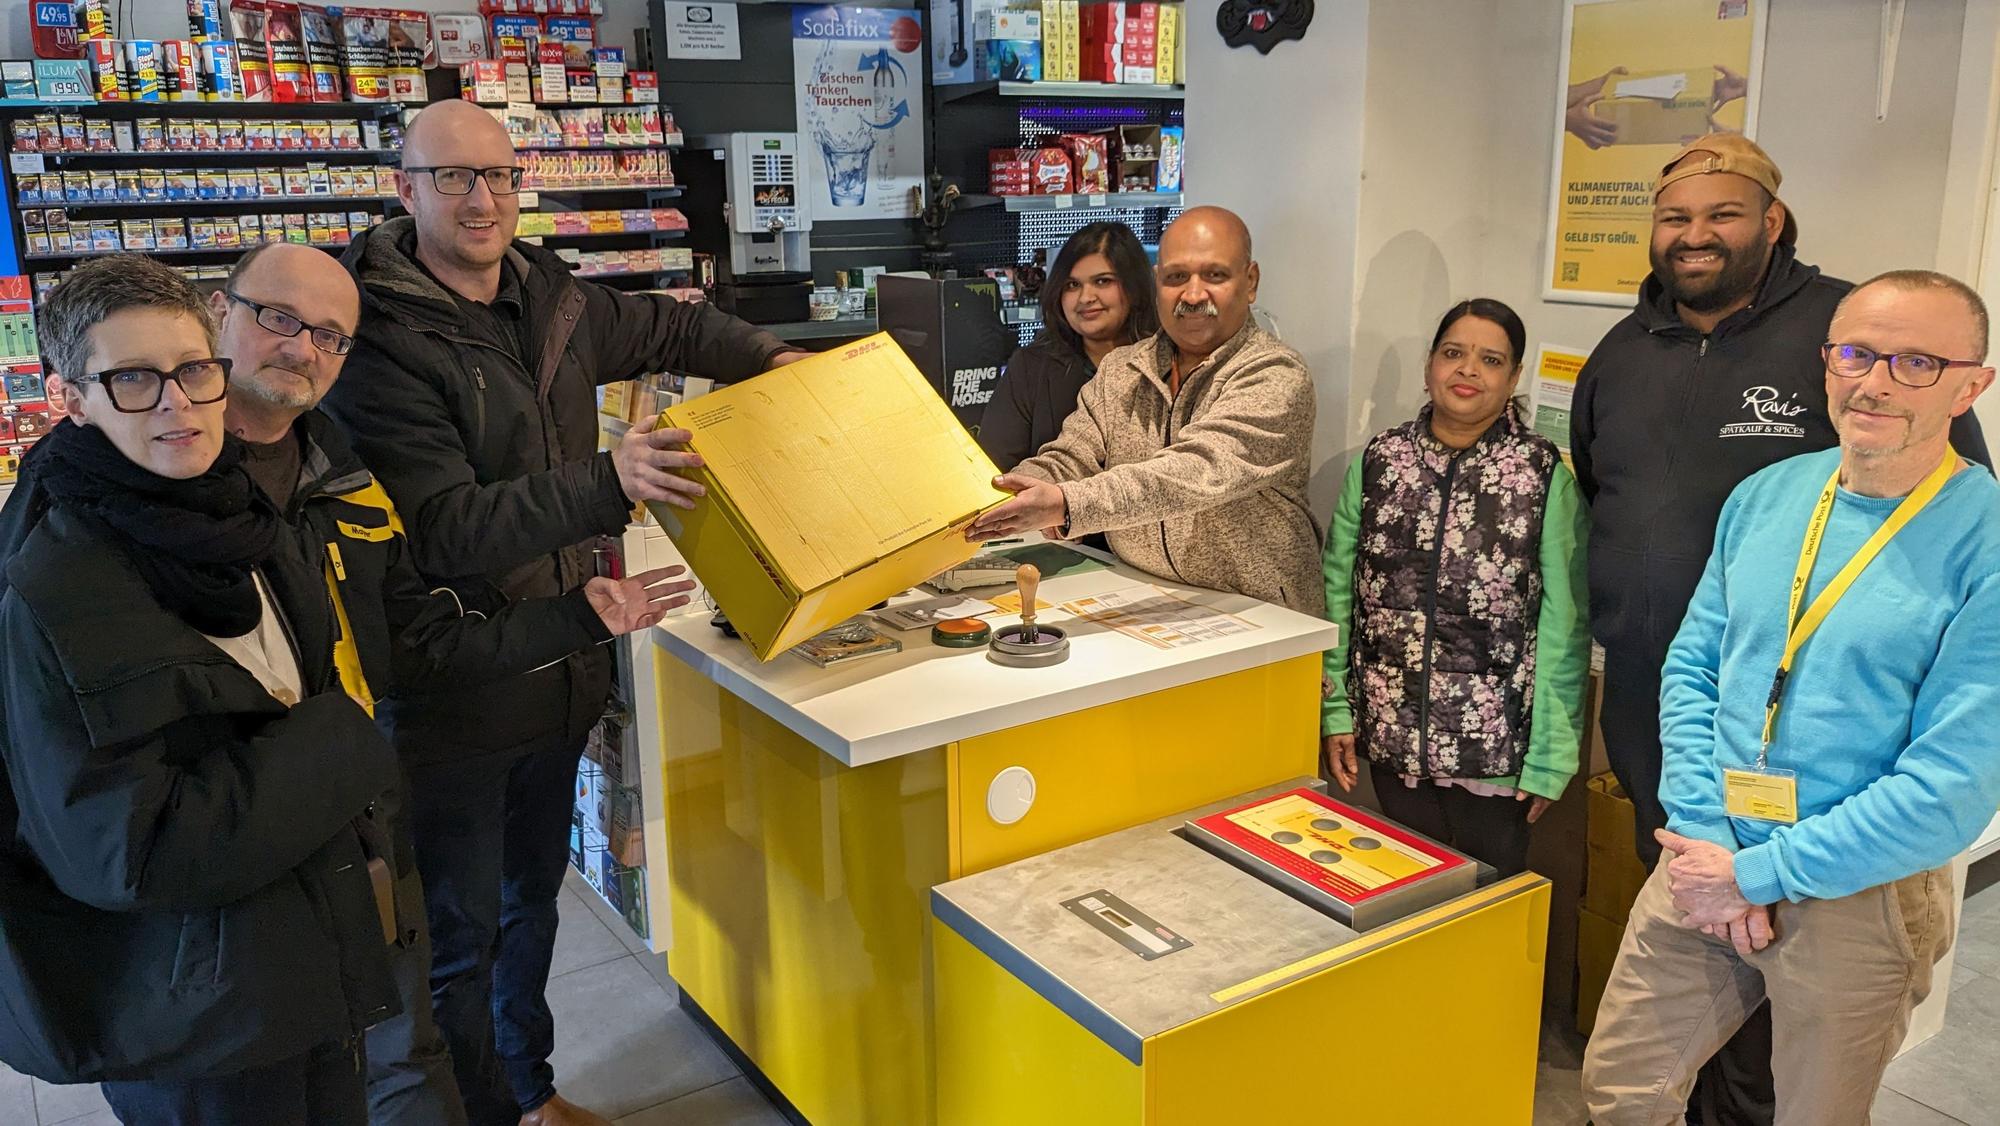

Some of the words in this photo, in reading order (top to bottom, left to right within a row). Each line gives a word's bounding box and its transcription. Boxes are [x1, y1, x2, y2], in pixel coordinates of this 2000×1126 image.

[802, 18, 879, 37] Sodafixx
[819, 72, 864, 84] Zischen
[806, 84, 848, 95] Trinken
[815, 96, 872, 106] Tauschen
[1568, 182, 1645, 192] KLIMANEUTRAL
[1567, 195, 1588, 205] UND
[1590, 195, 1619, 205] JETZT
[1620, 196, 1649, 206] AUCH
[1564, 232, 1589, 243] GELB
[1591, 233, 1606, 243] IST
[1608, 231, 1639, 245] GRÜN.
[953, 366, 997, 383] BRING
[953, 380, 981, 394] THE
[1741, 385, 1809, 423] Ravi's
[1764, 425, 1773, 433] &
[1773, 425, 1806, 435] SPICES
[1805, 521, 1821, 556] Deutsche
[1816, 505, 1827, 522] Post
